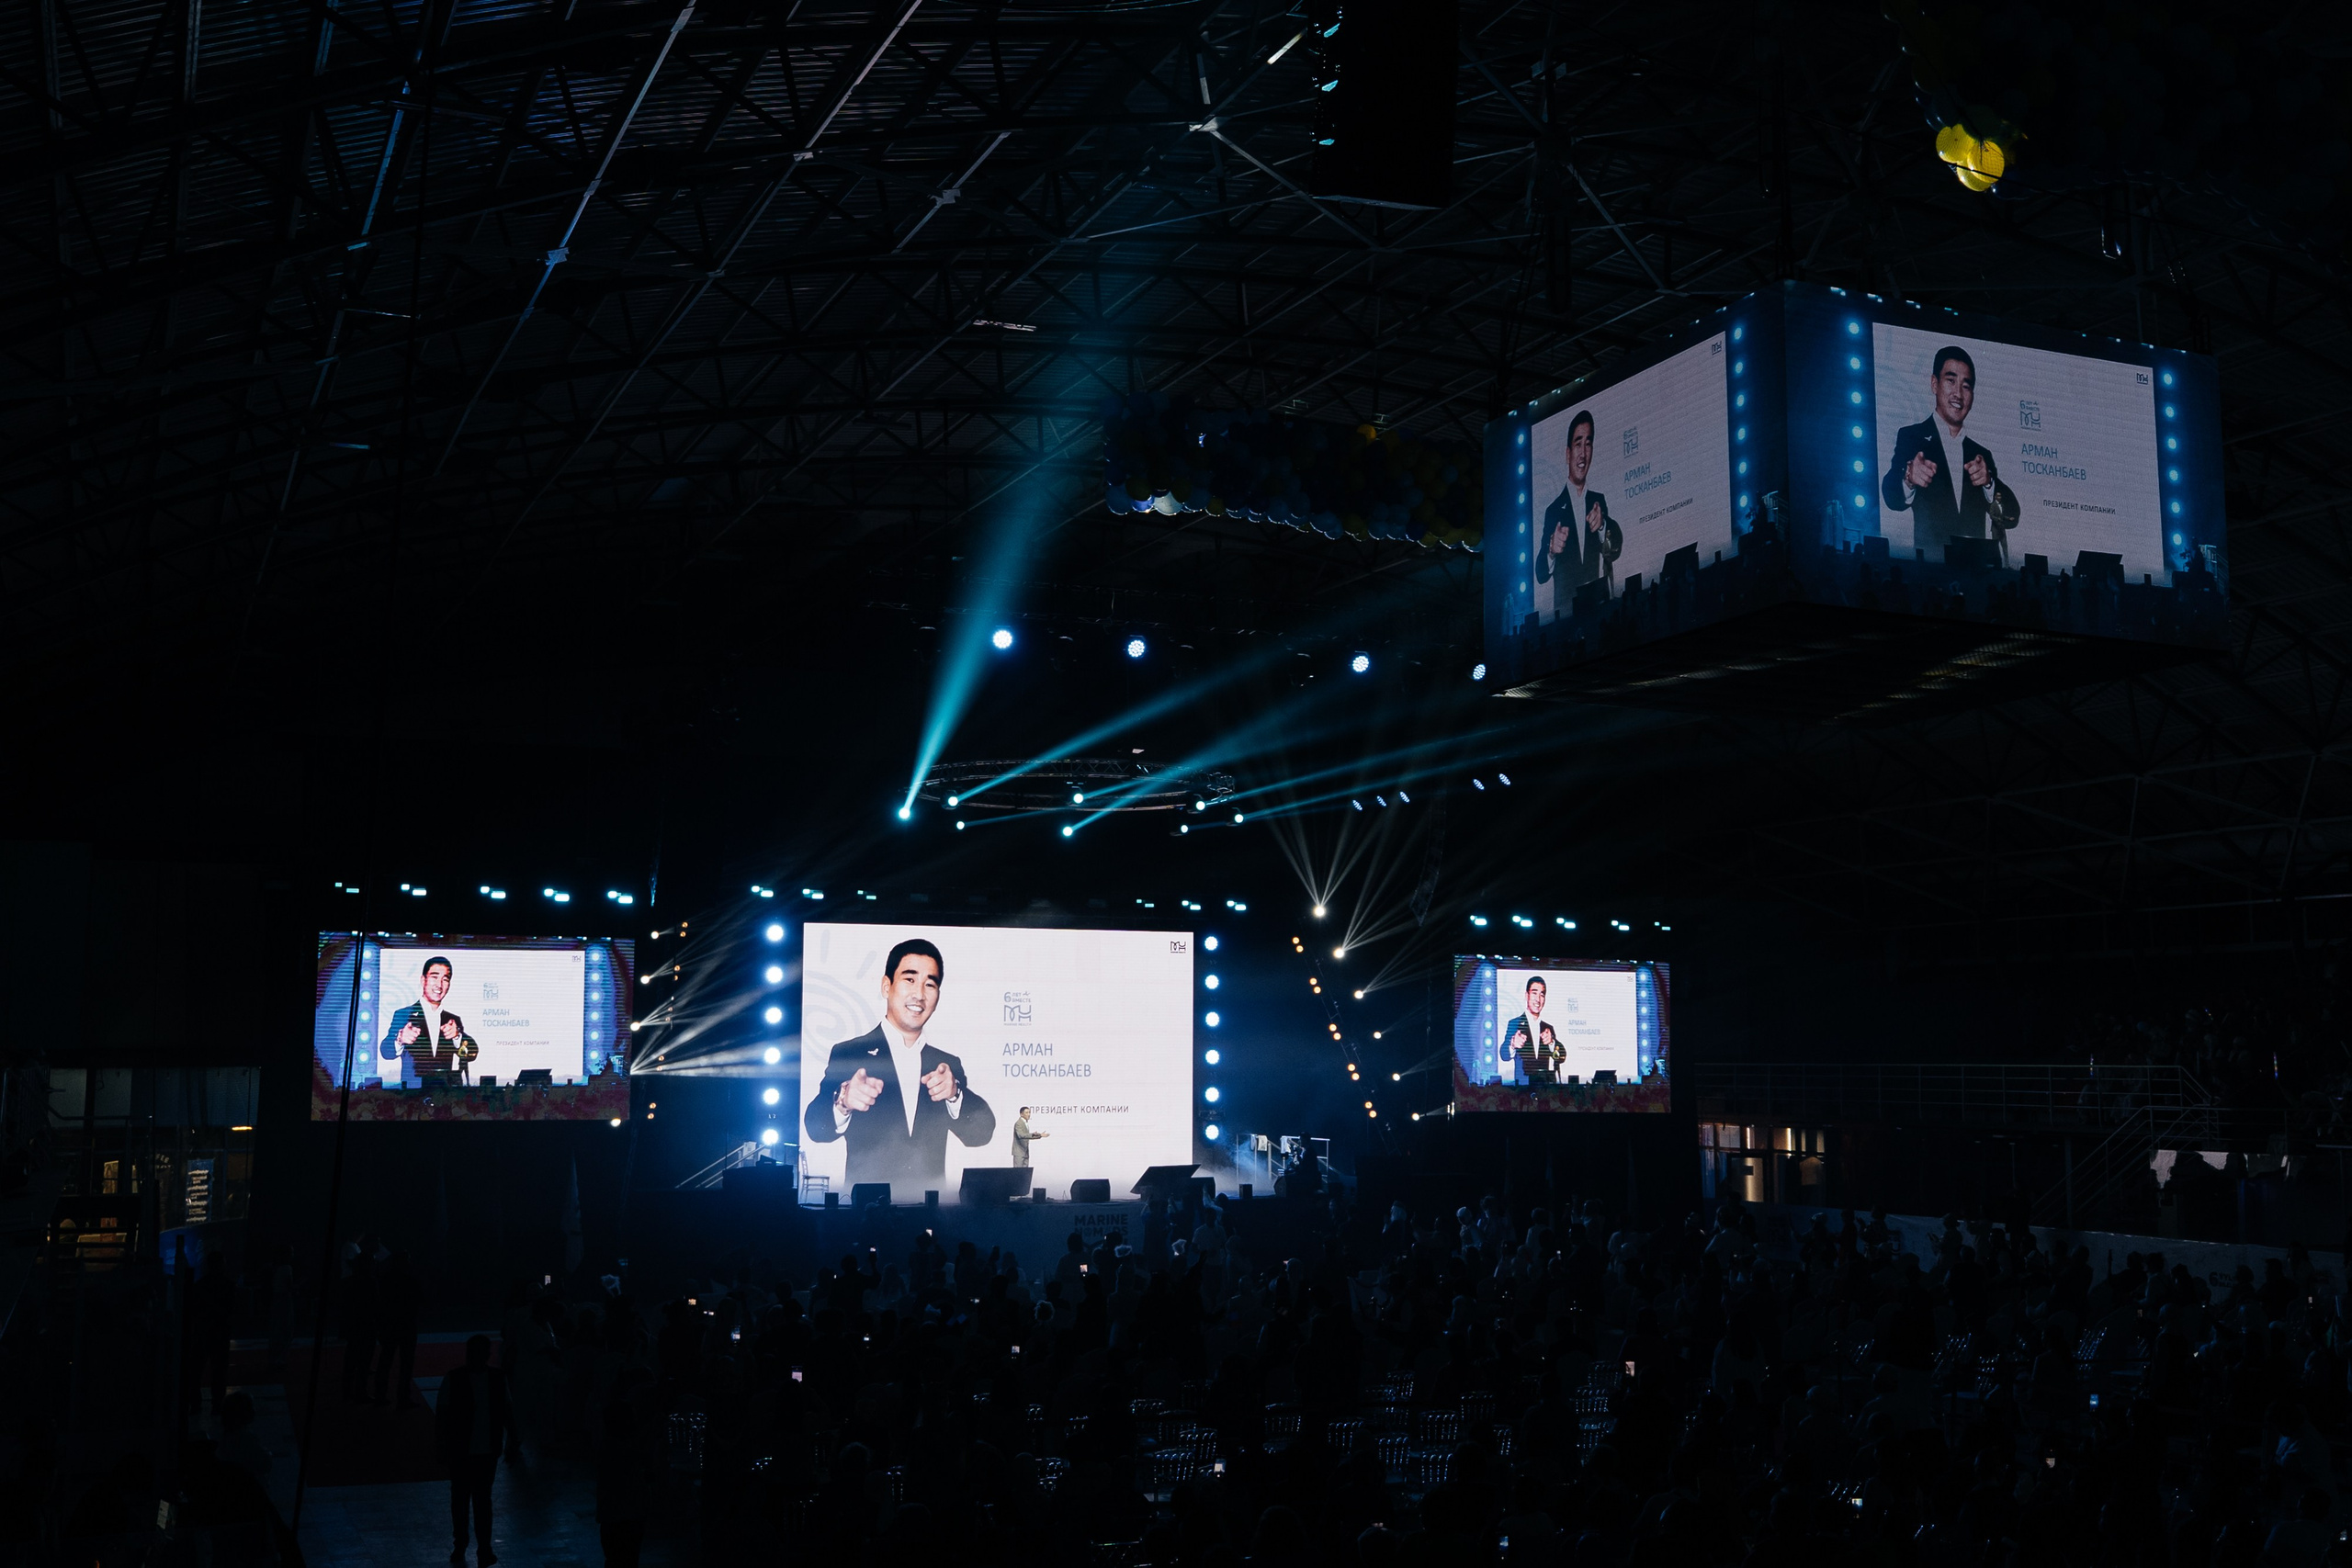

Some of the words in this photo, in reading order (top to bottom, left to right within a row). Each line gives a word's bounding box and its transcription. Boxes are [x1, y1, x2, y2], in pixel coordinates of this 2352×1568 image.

[2021, 443, 2058, 459] АРМАН
[1623, 462, 1651, 483] АРМАН
[2022, 460, 2086, 480] ТОСКАНБАЕВ
[1624, 470, 1672, 500] ТОСКАНБАЕВ
[2042, 499, 2078, 511] ПРЕЗИДЕНТ
[2080, 503, 2116, 514] КОМПАНИИ
[1003, 991, 1012, 1003] 6
[1002, 1043, 1053, 1056] АРМАН
[1002, 1064, 1091, 1077] ТОСКАНБАЕВ
[1030, 1105, 1078, 1114] ПРЕЗИДЕНТ
[1080, 1105, 1129, 1114] КОМПАНИИ
[1074, 1213, 1128, 1226] MARINE
